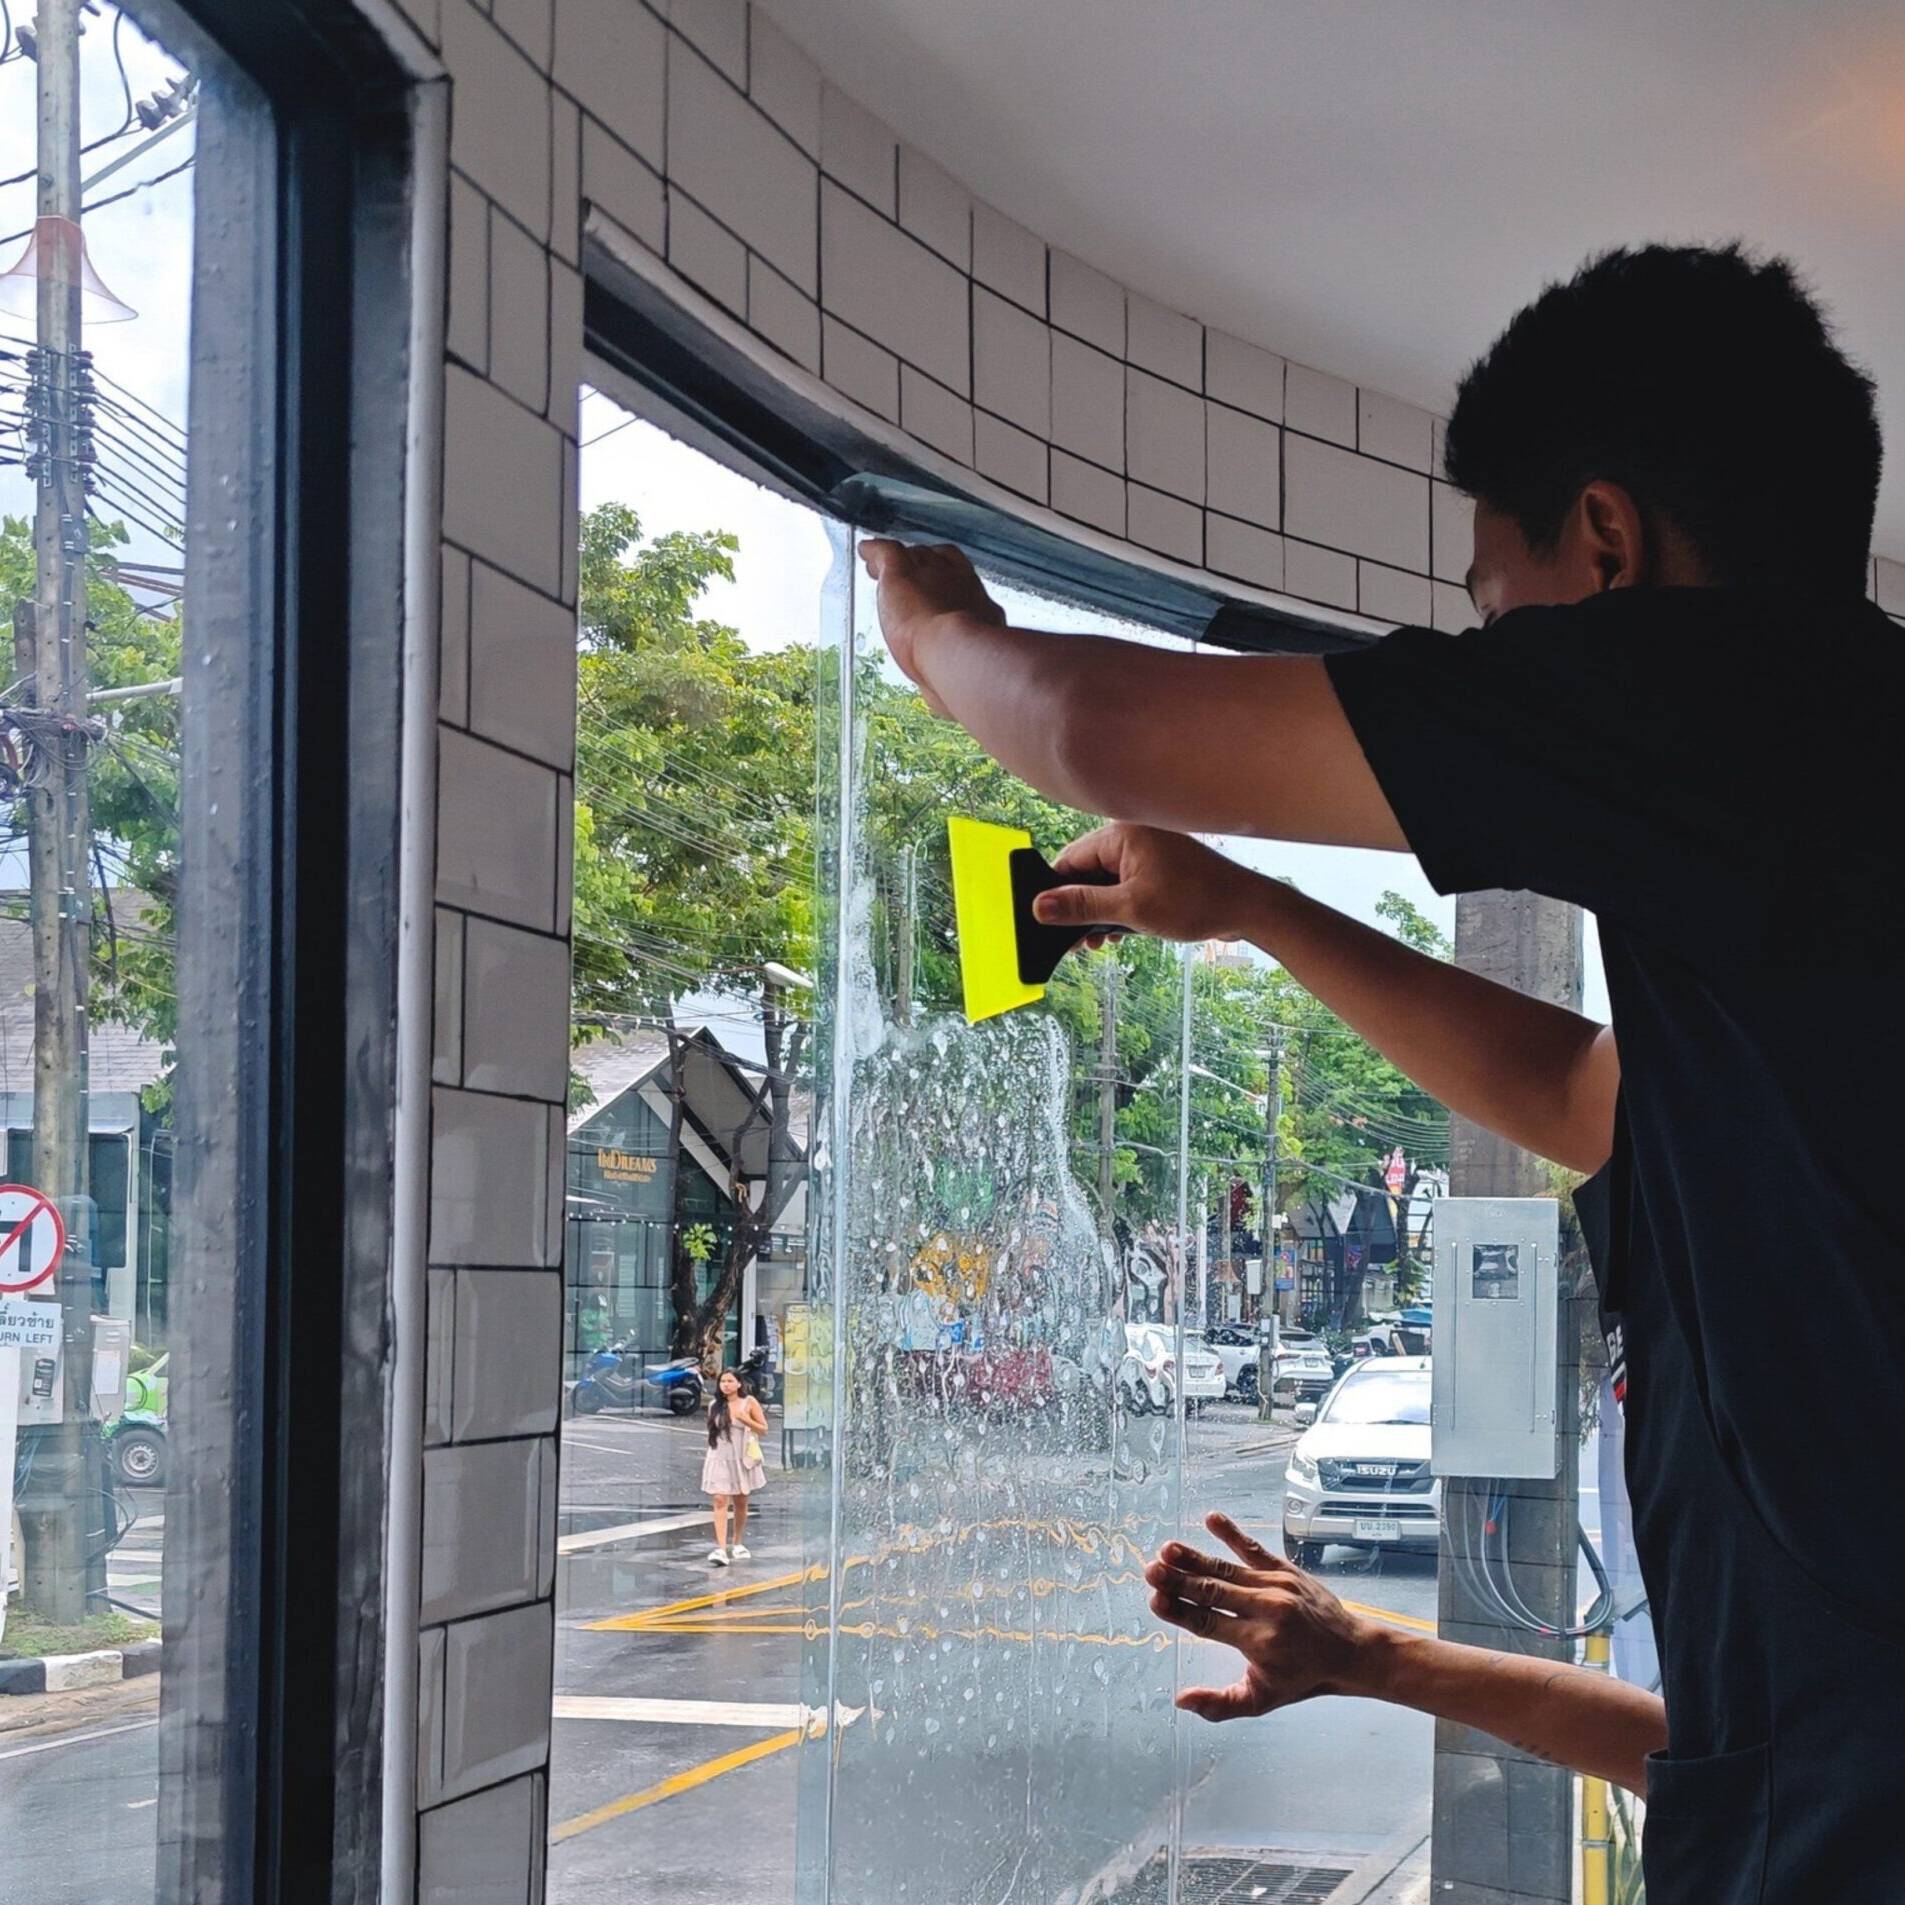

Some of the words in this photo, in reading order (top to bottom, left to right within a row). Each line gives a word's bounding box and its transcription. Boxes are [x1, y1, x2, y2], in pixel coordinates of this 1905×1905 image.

[0, 1303, 54, 1328] ลี้ยวซ้าย
[0, 1331, 20, 1342] URN
[26, 1333, 53, 1344] LEFT
[1356, 1464, 1398, 1476] ISUZU
